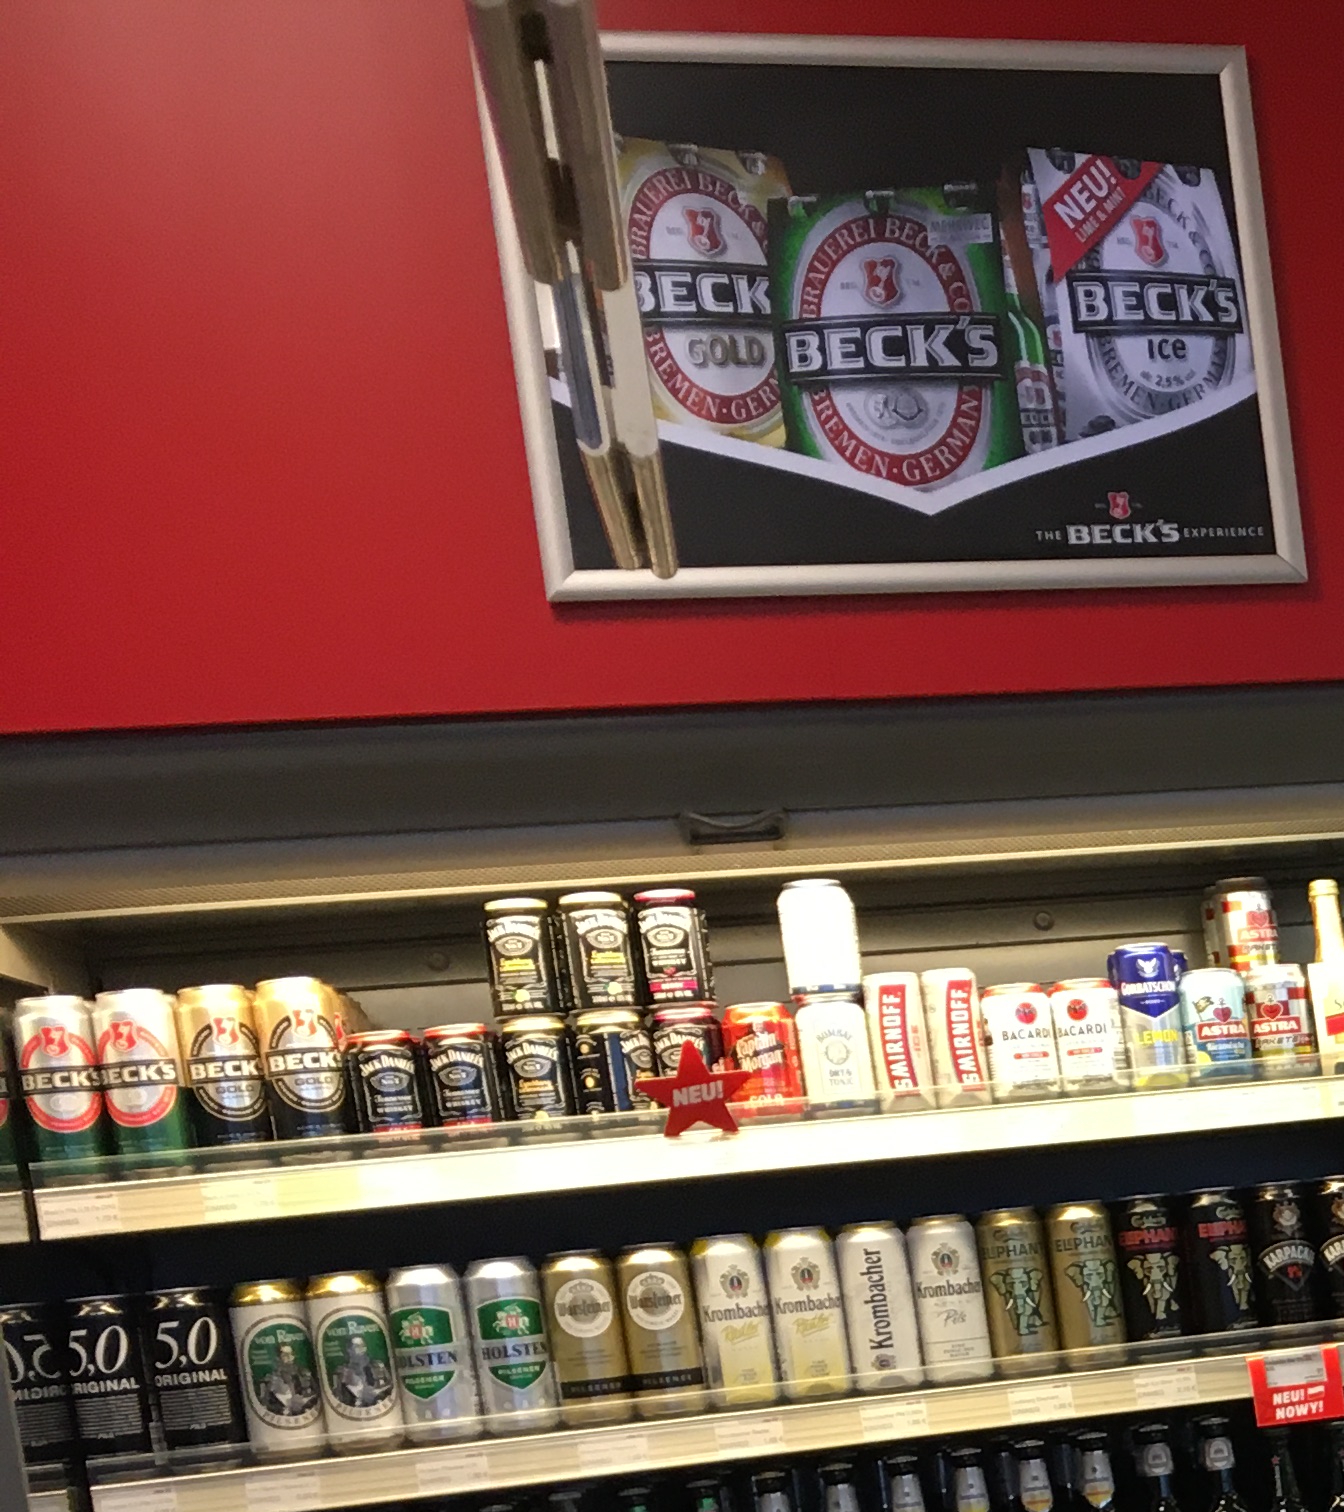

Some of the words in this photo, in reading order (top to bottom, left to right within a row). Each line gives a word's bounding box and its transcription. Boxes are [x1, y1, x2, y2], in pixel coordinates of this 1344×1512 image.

[1052, 166, 1119, 229] NEU!
[1078, 275, 1239, 325] BECK'S
[688, 332, 766, 369] GOLD
[786, 317, 999, 375] BECK'S
[1036, 529, 1062, 542] THE
[1068, 521, 1180, 545] BECK'S
[1184, 525, 1265, 539] EXPERIENCE
[1057, 1025, 1108, 1038] BACARDI
[1138, 1030, 1178, 1043] LEMON
[1201, 1024, 1246, 1037] ASTRA
[1253, 1019, 1298, 1033] ASTRA
[878, 990, 918, 1092] SMIRNOFF
[22, 1067, 100, 1091] BECK'S
[294, 1075, 334, 1088] GOLD
[672, 1081, 724, 1105] NEU!
[868, 1247, 895, 1351] Krombacher
[69, 1326, 128, 1376] 5,0
[155, 1316, 217, 1370] 5,0
[155, 1369, 227, 1387] ORIGINAL
[1272, 1388, 1304, 1407] NEU!
[1275, 1400, 1324, 1420] NOWY!
